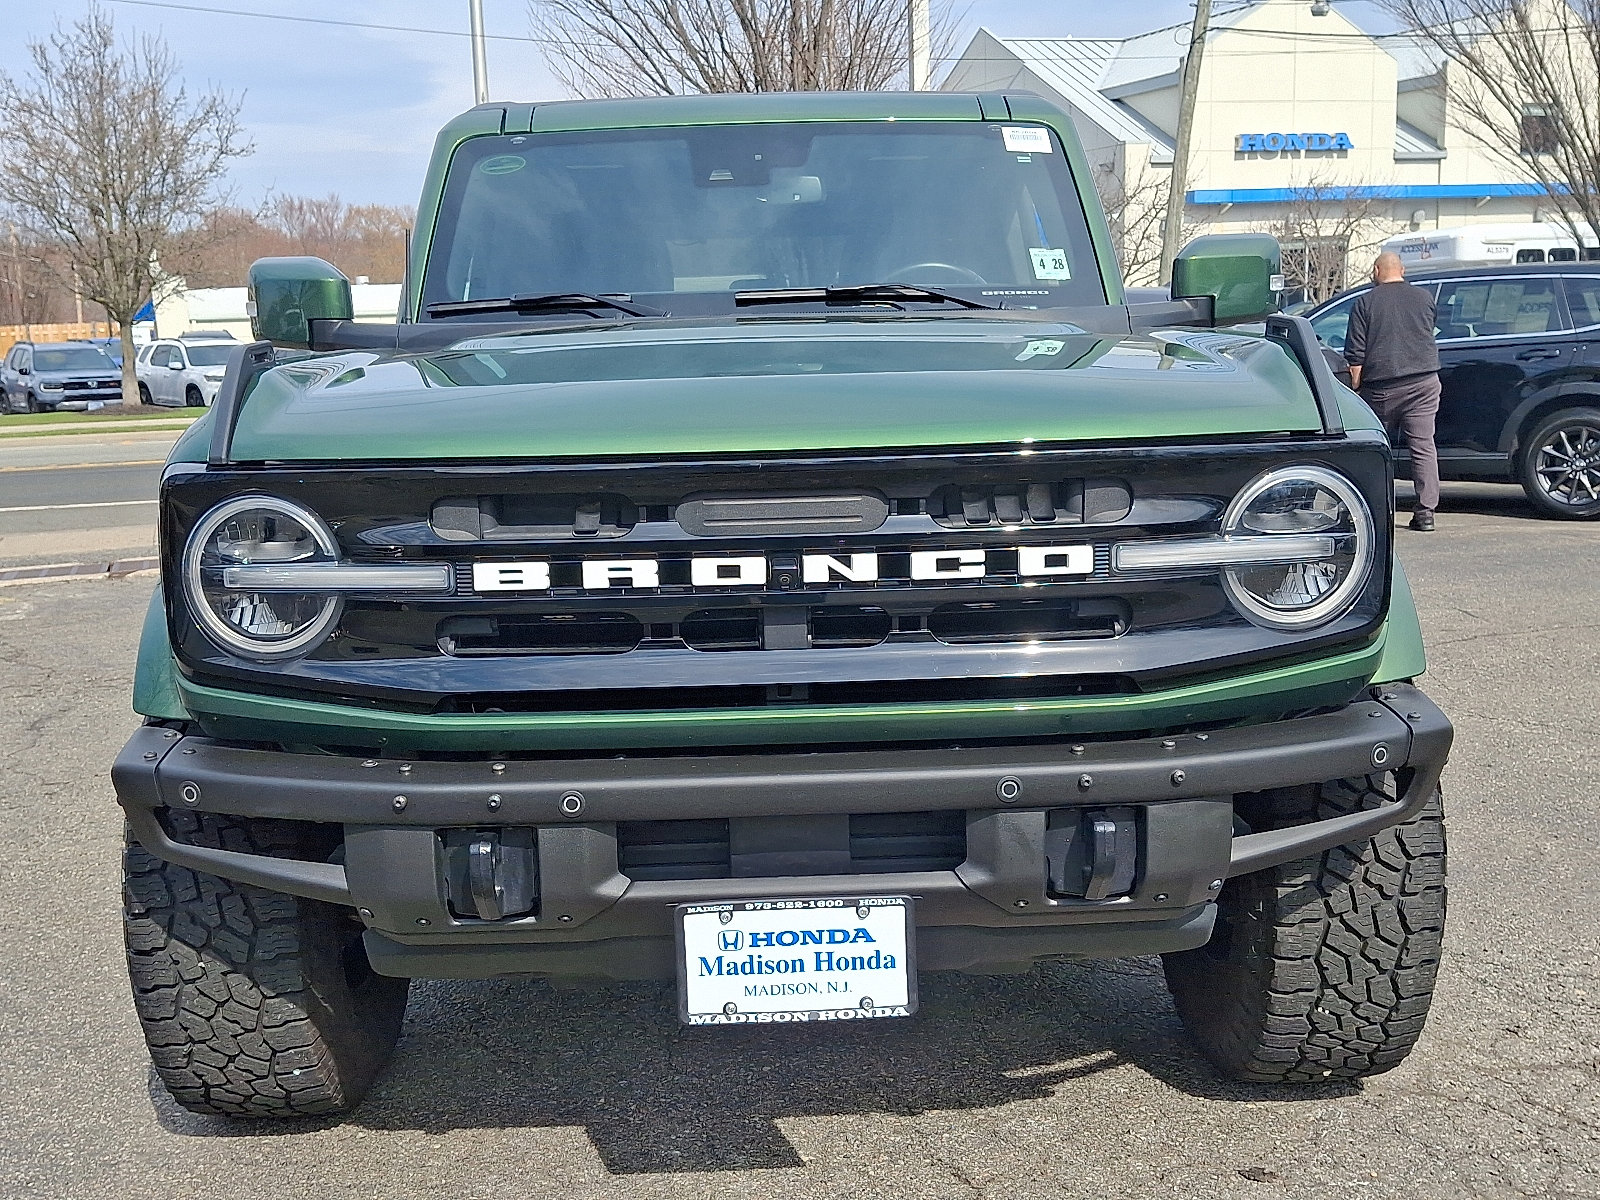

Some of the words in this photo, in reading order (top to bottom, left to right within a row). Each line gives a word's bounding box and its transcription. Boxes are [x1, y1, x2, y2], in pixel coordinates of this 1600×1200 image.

[1238, 132, 1355, 152] HONDA
[1039, 258, 1046, 270] 4
[1052, 258, 1065, 270] 28
[472, 544, 1094, 592] BRONCO
[686, 904, 734, 914] MADISON
[744, 899, 844, 911] 973-822-1600
[858, 897, 906, 907] HONDA
[748, 927, 877, 948] HONDA
[698, 954, 806, 976] Madison
[813, 949, 897, 972] Honda
[744, 982, 823, 997] MADISON,
[827, 981, 853, 994] N.J.
[688, 1011, 811, 1025] MADISON
[817, 1006, 911, 1021] HONDA
